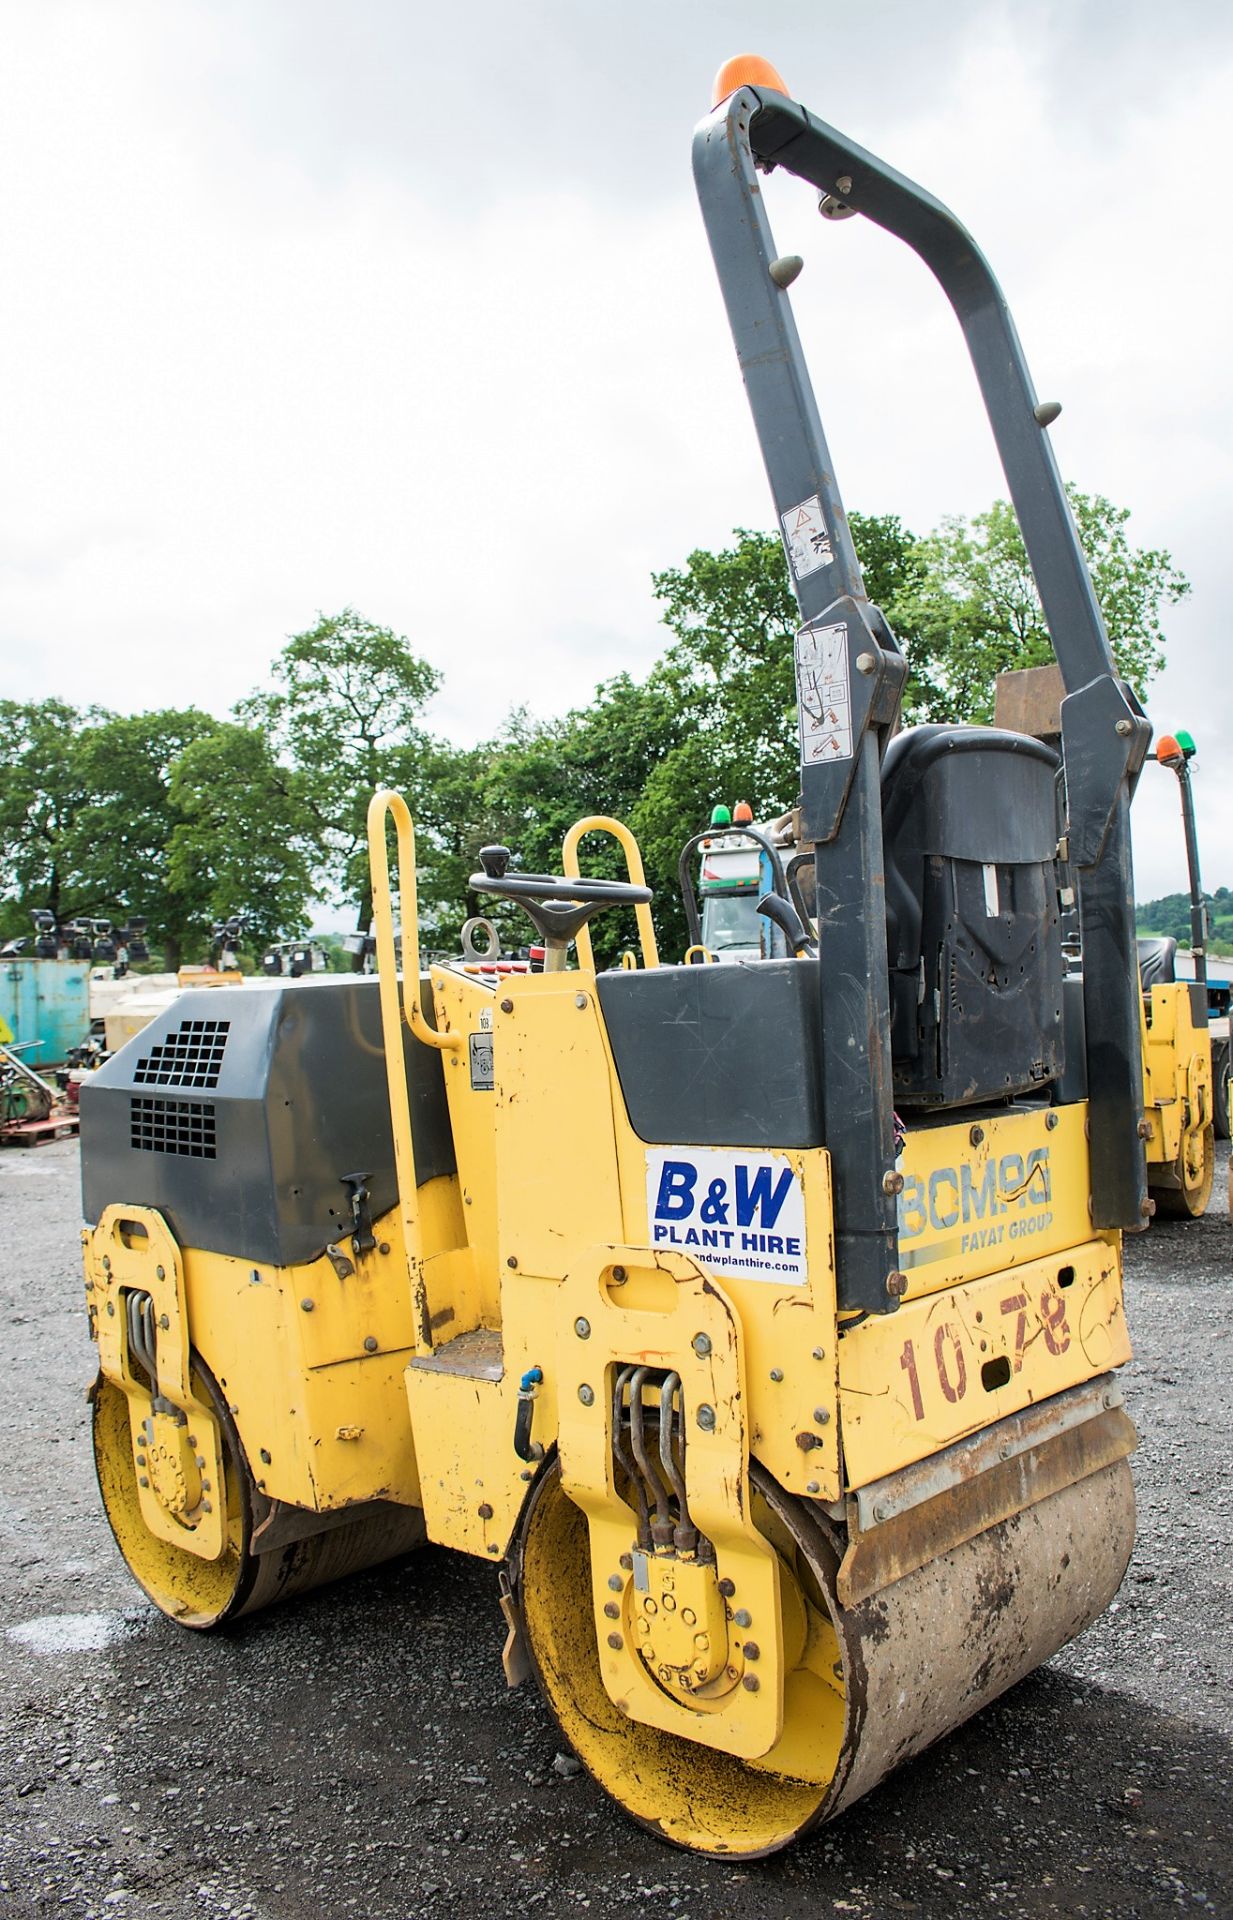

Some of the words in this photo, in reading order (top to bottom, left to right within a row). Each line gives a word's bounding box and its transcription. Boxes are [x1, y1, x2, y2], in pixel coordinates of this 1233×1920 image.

[653, 1224, 735, 1249] PLANT
[740, 1232, 801, 1256] HIRE
[961, 1225, 1004, 1255] FAYAT
[1008, 1211, 1053, 1240] GROUP
